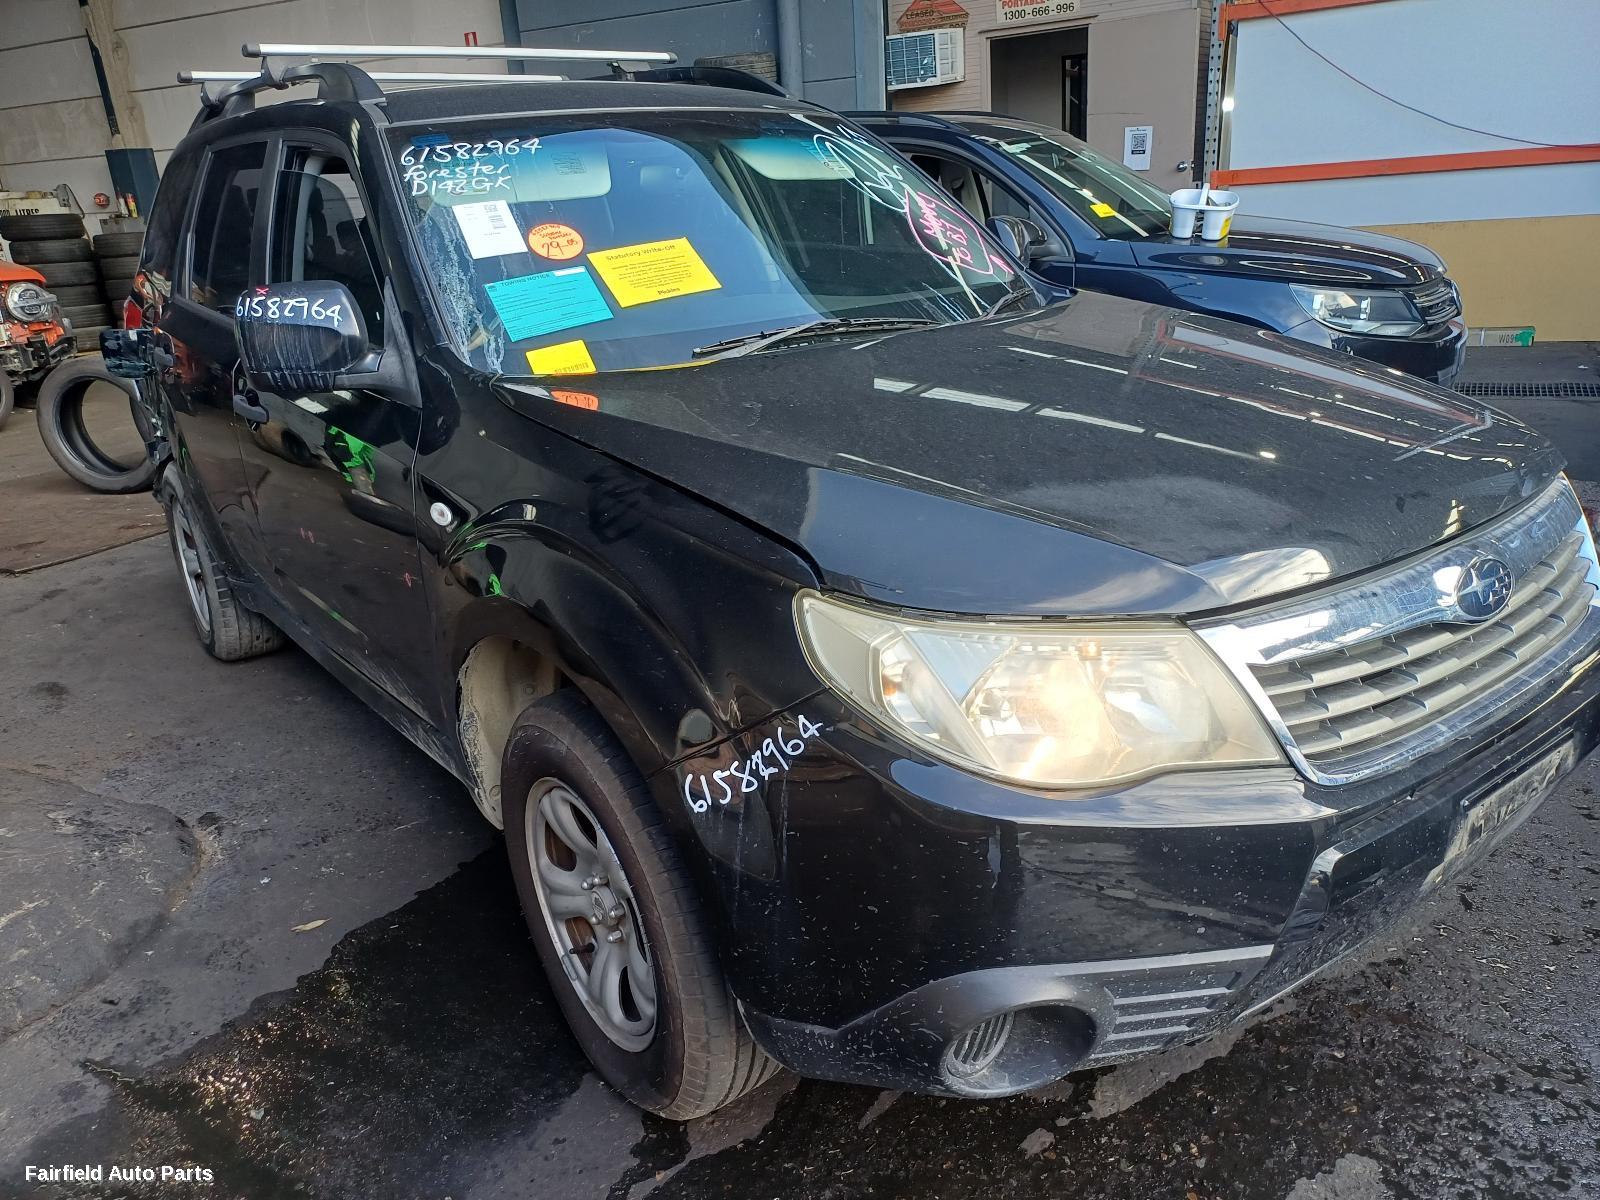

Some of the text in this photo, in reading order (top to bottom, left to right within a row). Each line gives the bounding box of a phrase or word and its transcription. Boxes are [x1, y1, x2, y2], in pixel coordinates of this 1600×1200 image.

[1003, 2, 1075, 21] 1300-666-996
[400, 138, 542, 166] 61582964
[236, 296, 342, 327] 61582964
[684, 714, 823, 813] 61582964
